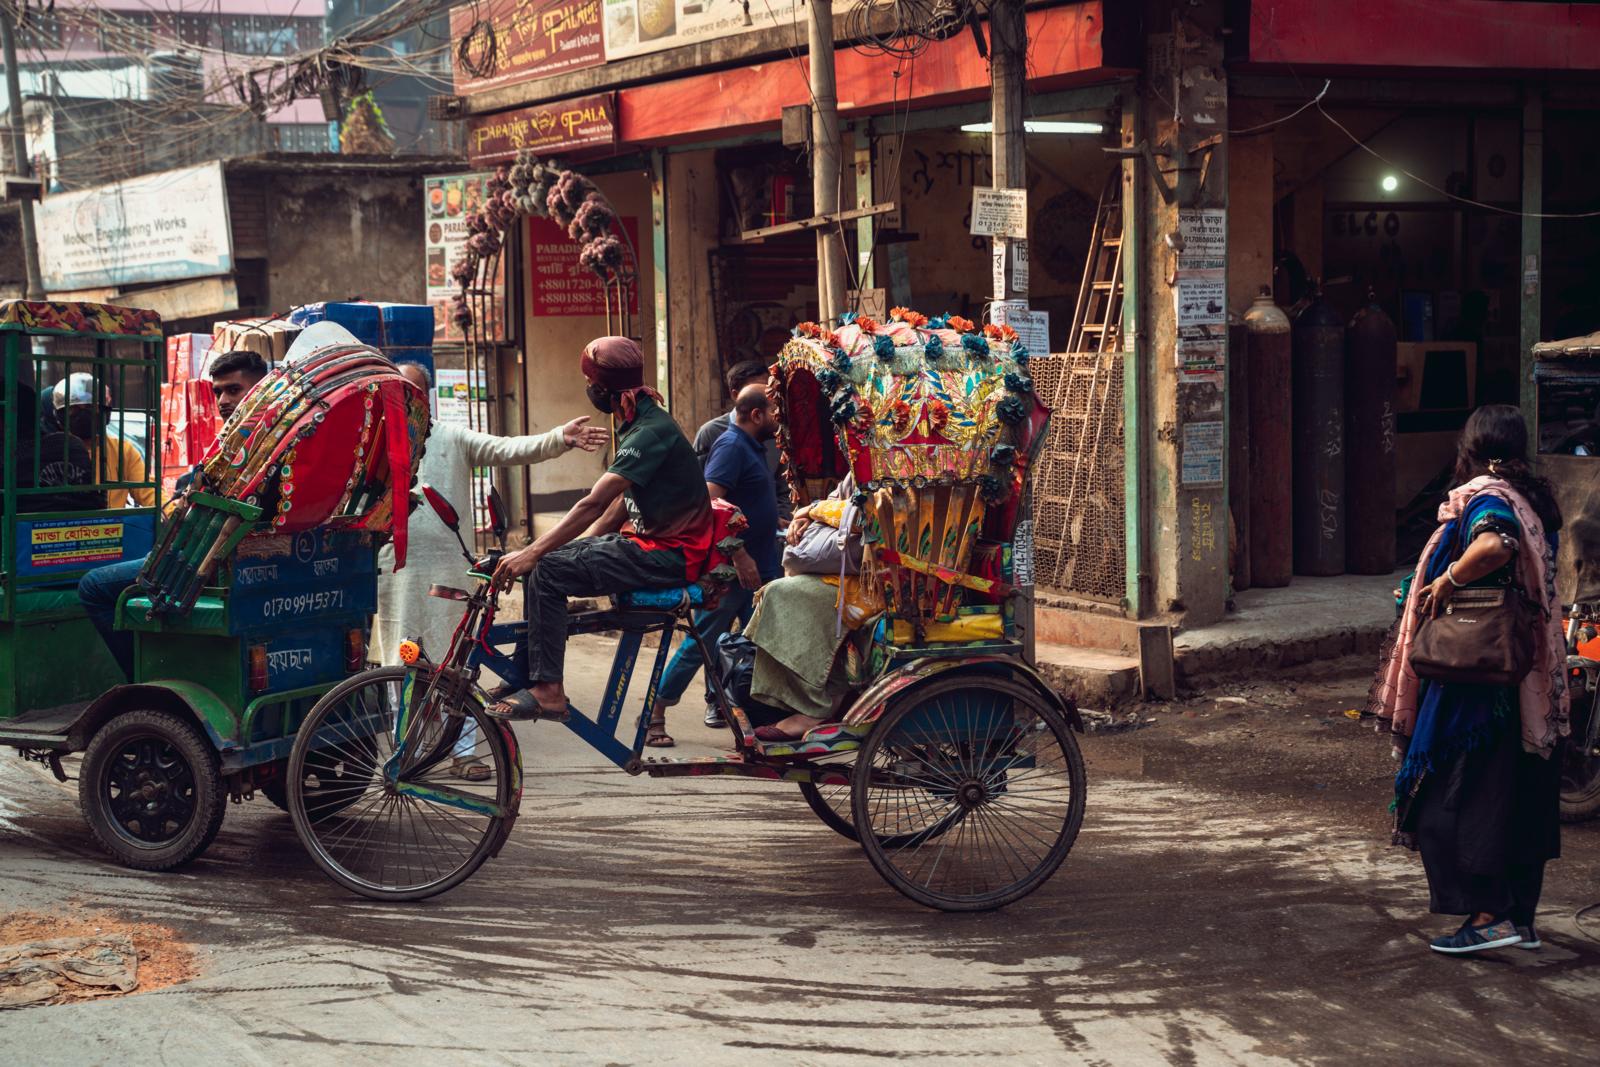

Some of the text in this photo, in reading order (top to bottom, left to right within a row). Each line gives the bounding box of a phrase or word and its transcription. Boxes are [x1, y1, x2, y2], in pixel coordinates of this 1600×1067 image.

[63, 216, 187, 246] Modern Engineering Works
[536, 244, 581, 254] PARADIS
[103, 526, 121, 537] হল
[263, 589, 344, 617] 01709945371
